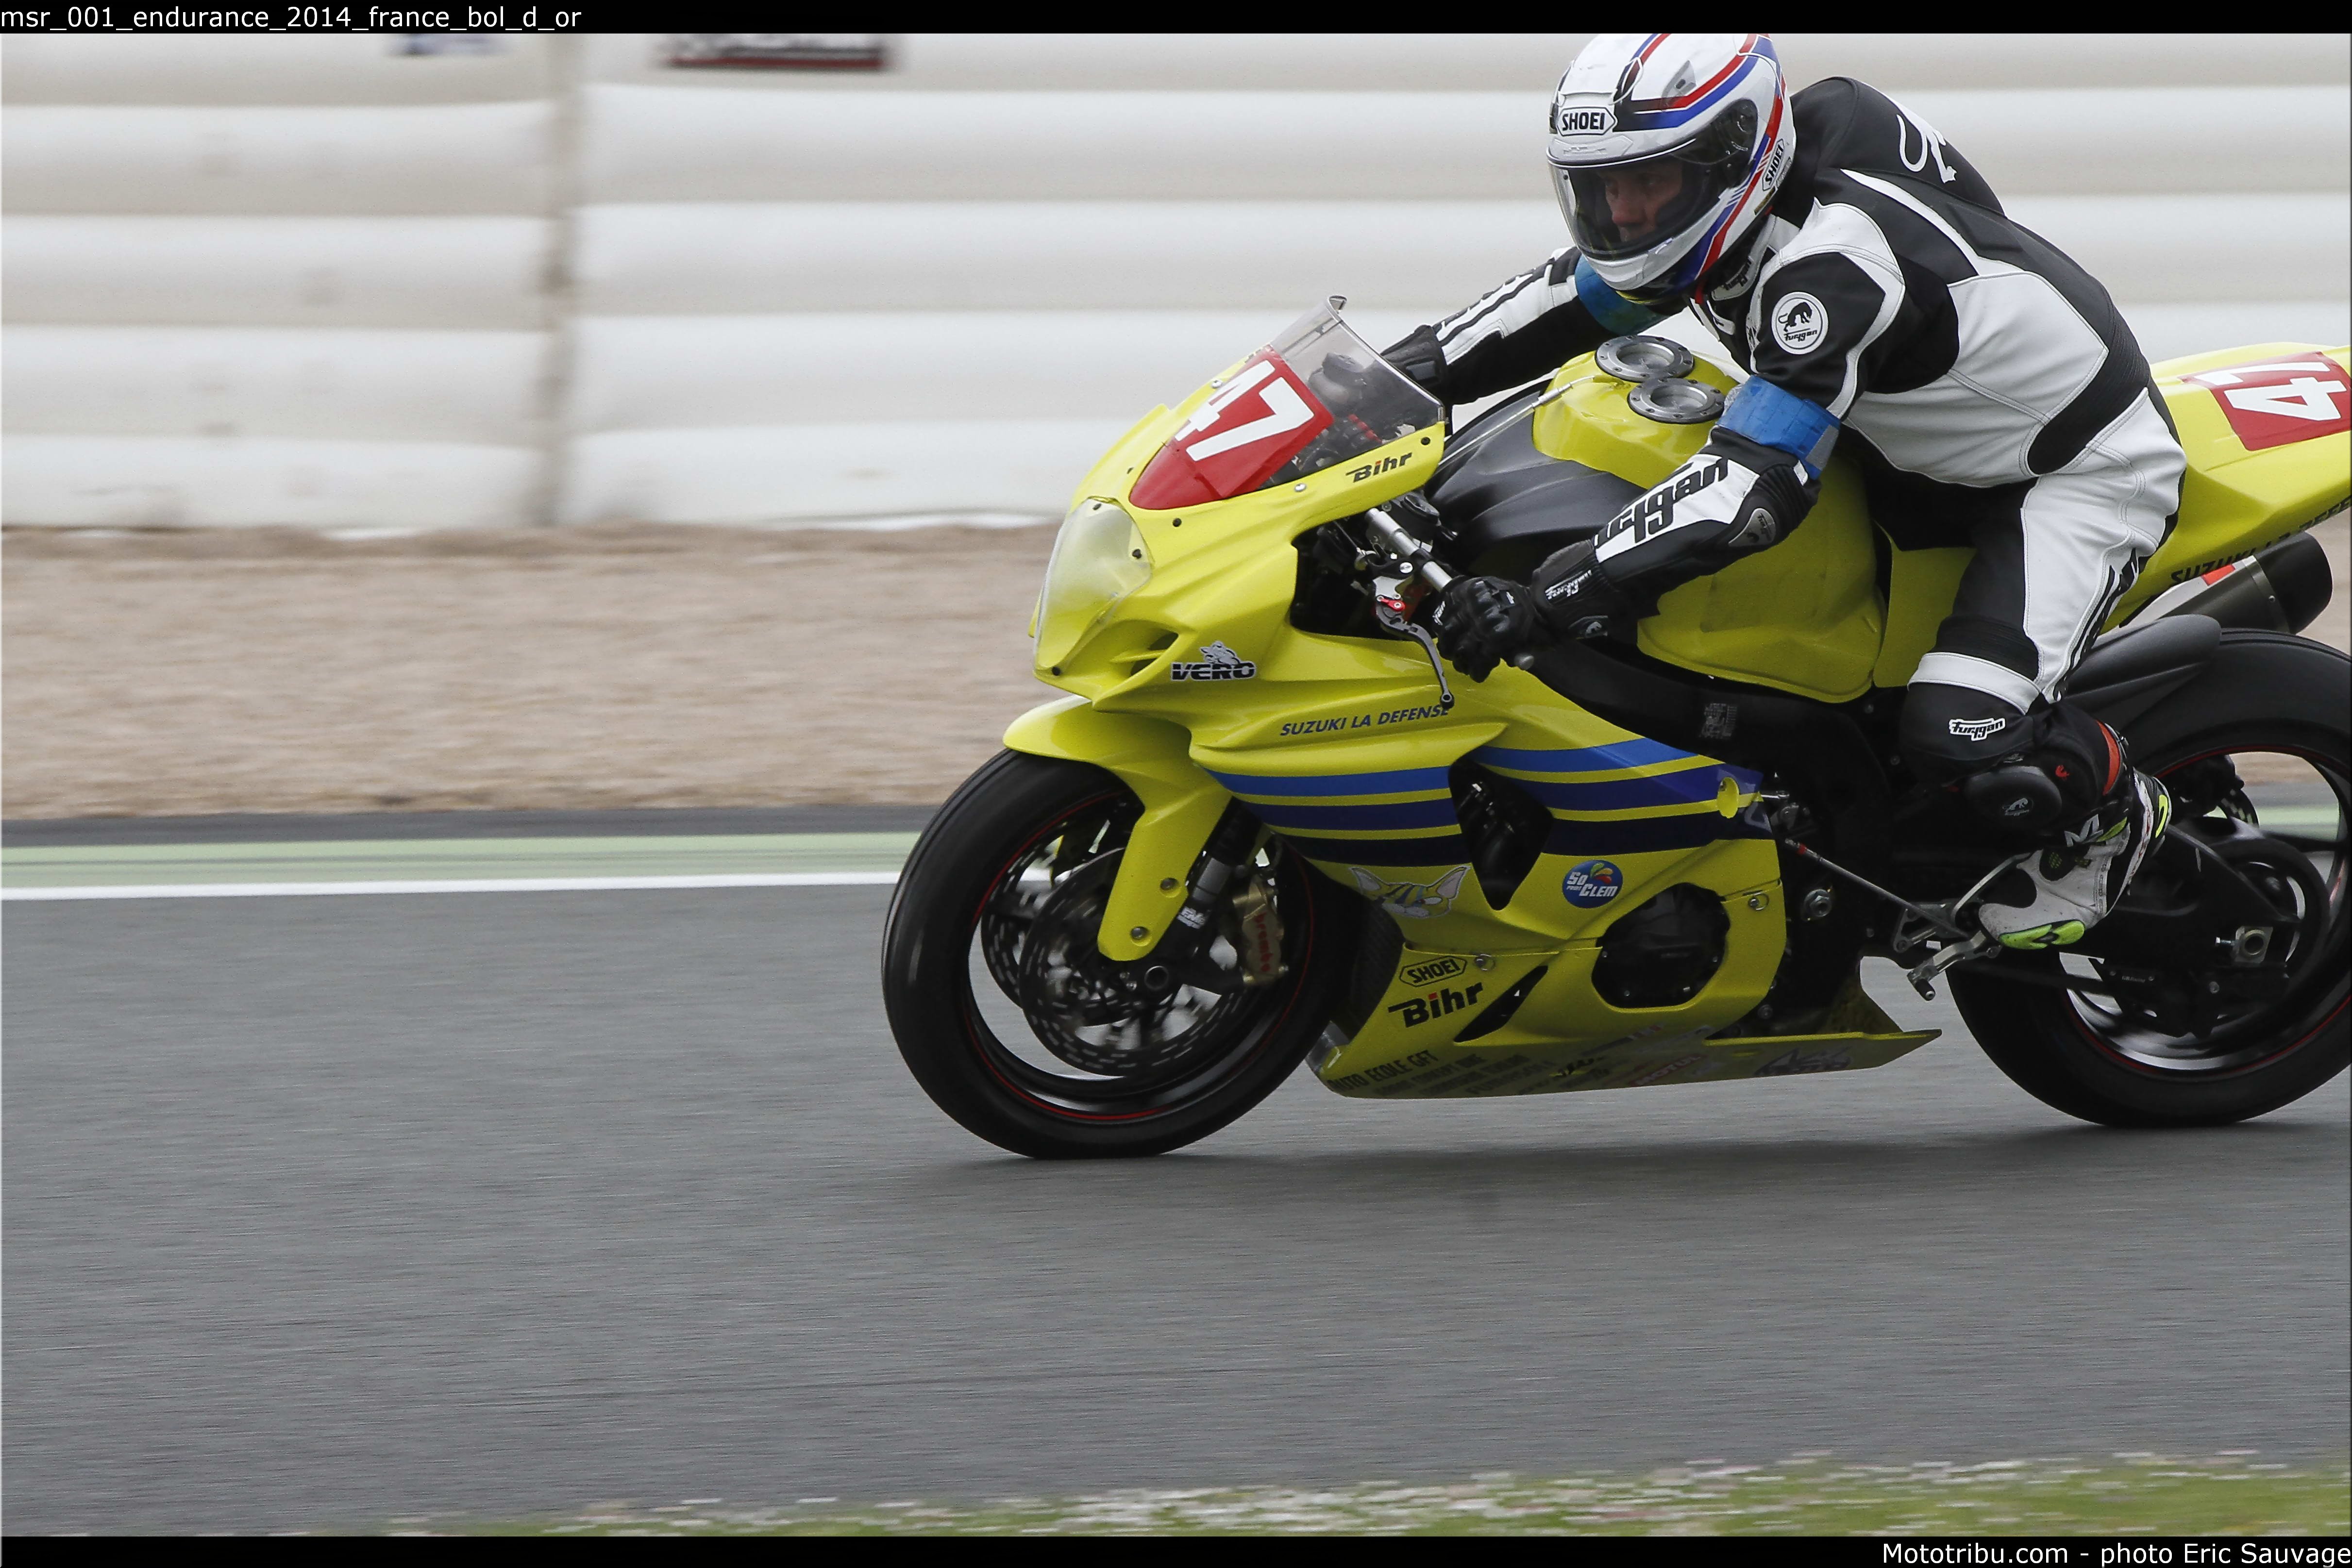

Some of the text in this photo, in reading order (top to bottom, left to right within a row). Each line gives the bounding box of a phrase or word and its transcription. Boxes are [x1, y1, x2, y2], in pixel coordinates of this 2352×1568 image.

[1562, 112, 1606, 131] SHOEI
[1765, 144, 1784, 185] SHOEI
[2193, 362, 2348, 421] 47
[1174, 360, 1314, 462] 47
[1345, 452, 1412, 483] Bihr
[1172, 662, 1256, 680] VERO
[1280, 717, 1347, 736] SUZUKI
[1351, 715, 1371, 728] LA
[1579, 884, 1618, 897] CLEM
[1407, 959, 1461, 984] SHOEI
[1388, 982, 1483, 1028] Bihr
[1363, 1060, 1413, 1082] ECOLE
